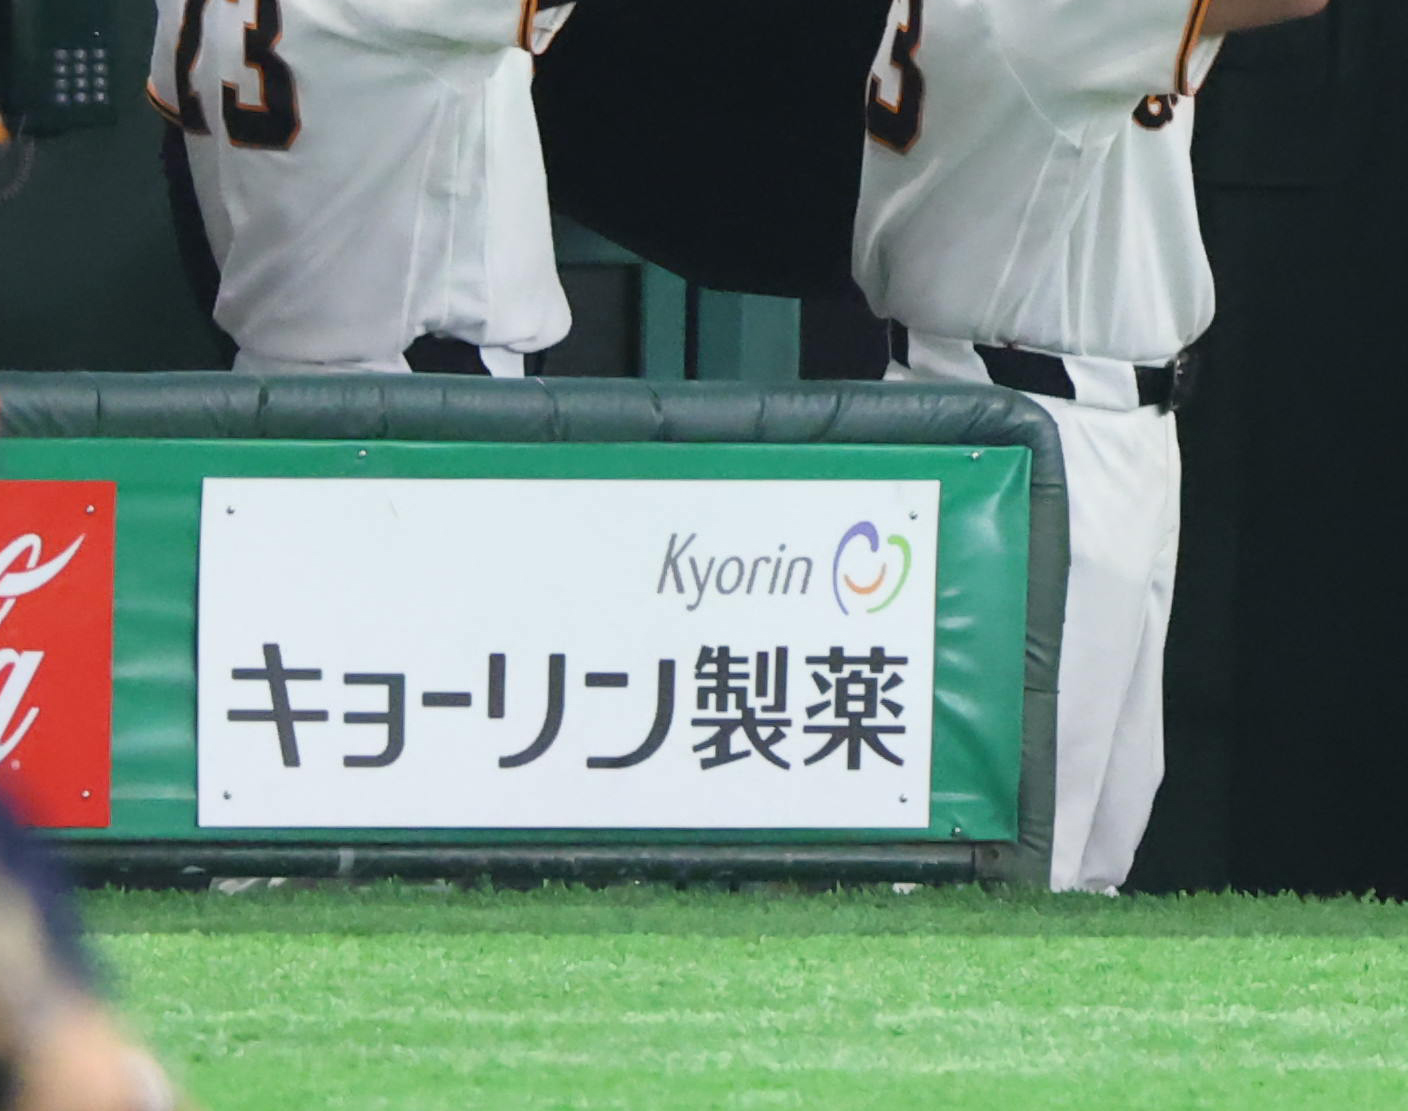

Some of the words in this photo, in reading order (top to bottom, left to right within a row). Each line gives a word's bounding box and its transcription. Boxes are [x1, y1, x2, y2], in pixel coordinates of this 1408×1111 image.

[656, 532, 814, 612] Kyorin
[226, 642, 909, 772] キョーリン製薬
